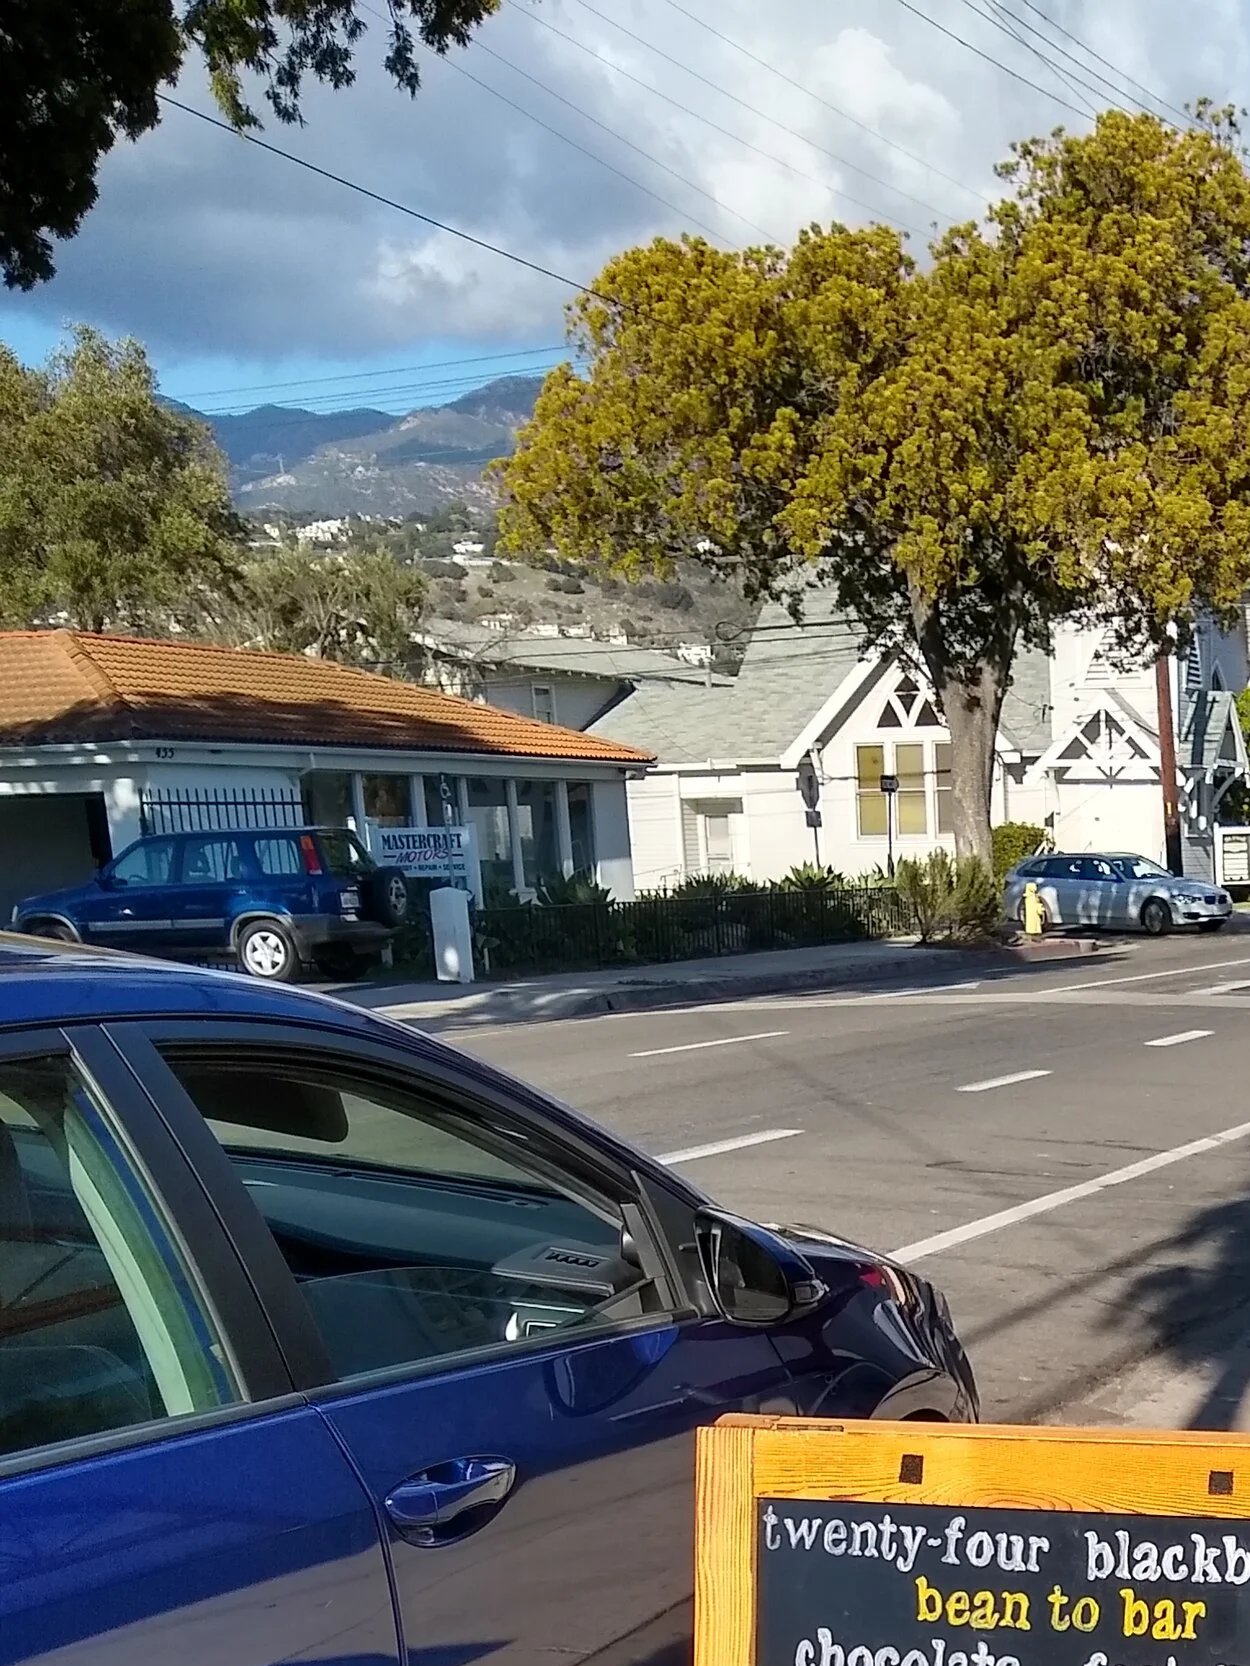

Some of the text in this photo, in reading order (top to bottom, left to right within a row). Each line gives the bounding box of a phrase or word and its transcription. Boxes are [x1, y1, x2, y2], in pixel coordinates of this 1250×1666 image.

[381, 833, 463, 850] MASTERCRAFT
[396, 848, 450, 864] MOTORS
[762, 1504, 1050, 1573] twenty-four
[915, 1575, 1207, 1641] bean to bar
